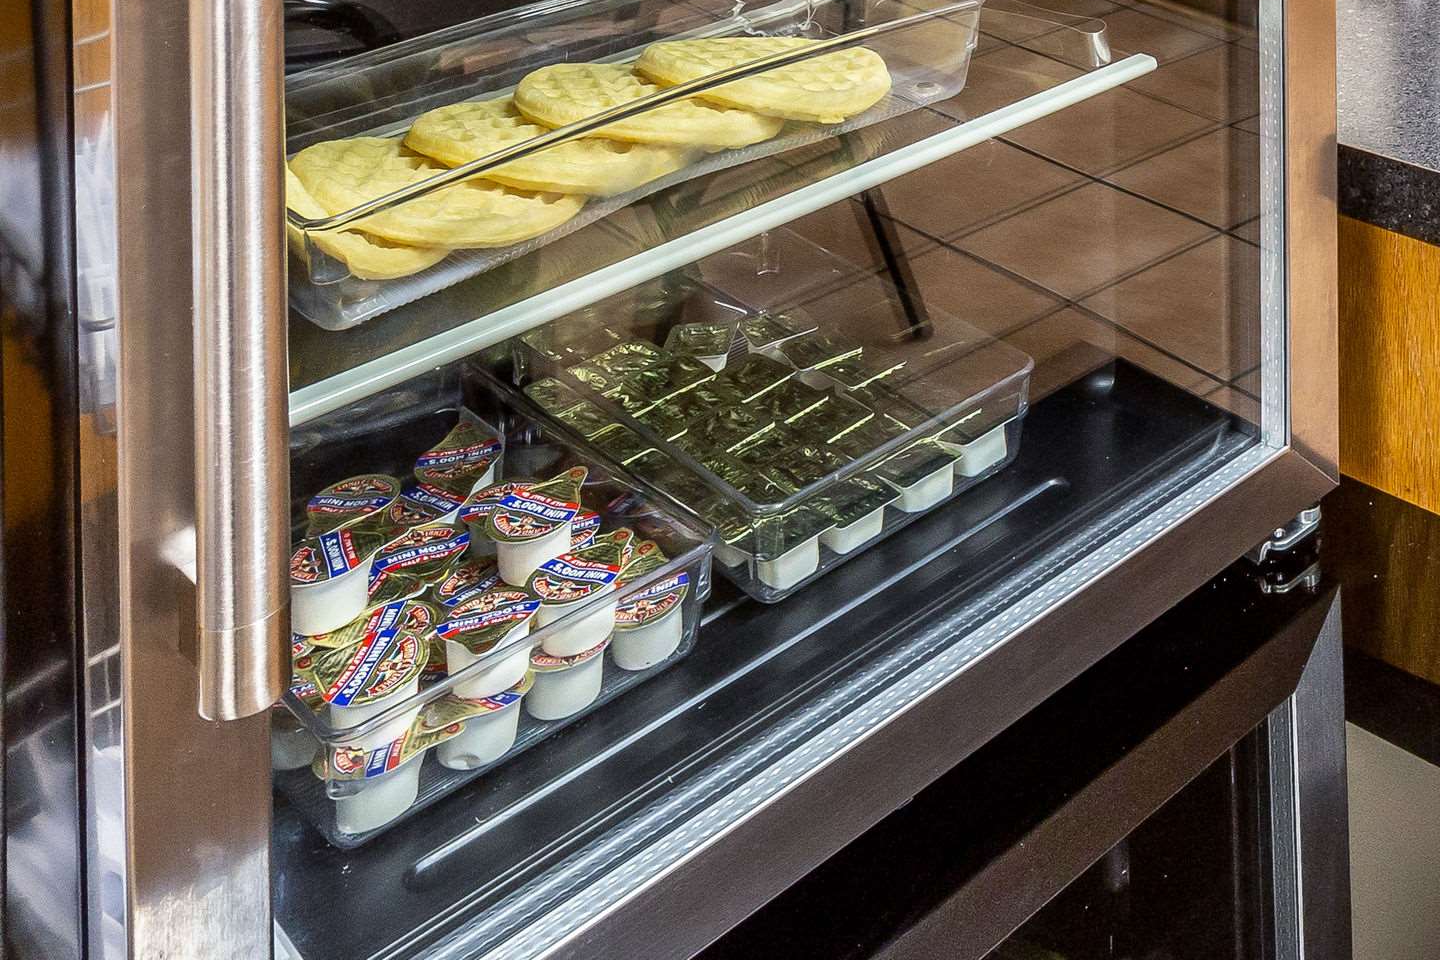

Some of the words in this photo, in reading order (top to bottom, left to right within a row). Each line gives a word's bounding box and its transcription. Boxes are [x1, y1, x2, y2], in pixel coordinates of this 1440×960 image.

[512, 501, 545, 517] MOO'S
[546, 509, 568, 521] MINI
[387, 551, 416, 564] MINI
[418, 542, 456, 554] MOO'S
[553, 562, 582, 579] MOO'S
[581, 568, 608, 581] MINI
[448, 617, 480, 628] MINI
[480, 604, 524, 622] MOO'S
[368, 636, 390, 662] MINI
[344, 662, 371, 696] MOO'S
